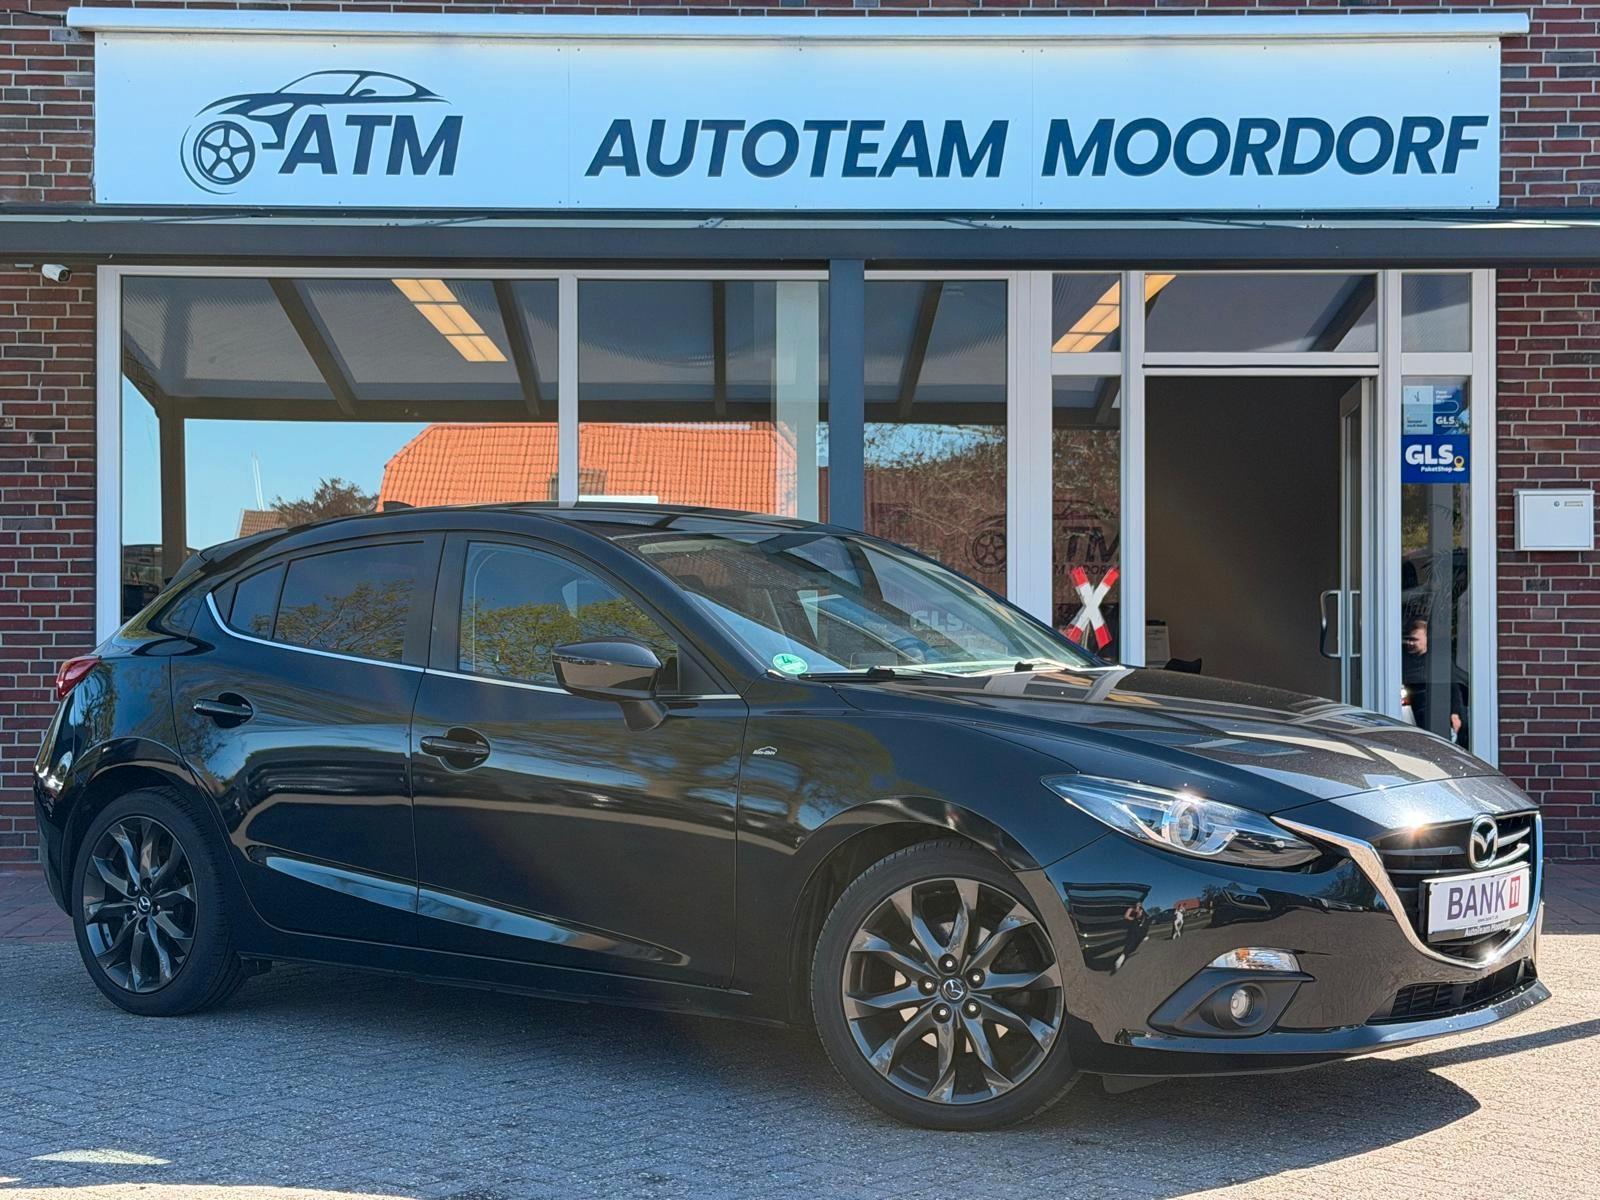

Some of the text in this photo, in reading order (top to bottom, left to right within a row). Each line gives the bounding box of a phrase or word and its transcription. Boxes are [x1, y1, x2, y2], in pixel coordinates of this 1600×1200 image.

[278, 114, 463, 176] ATM
[584, 115, 1489, 178] AUTOTEAM MOORDORF
[1435, 416, 1455, 425] GLS
[1405, 444, 1454, 465] GLS
[910, 610, 963, 631] GLS
[1447, 880, 1507, 920] BANK
